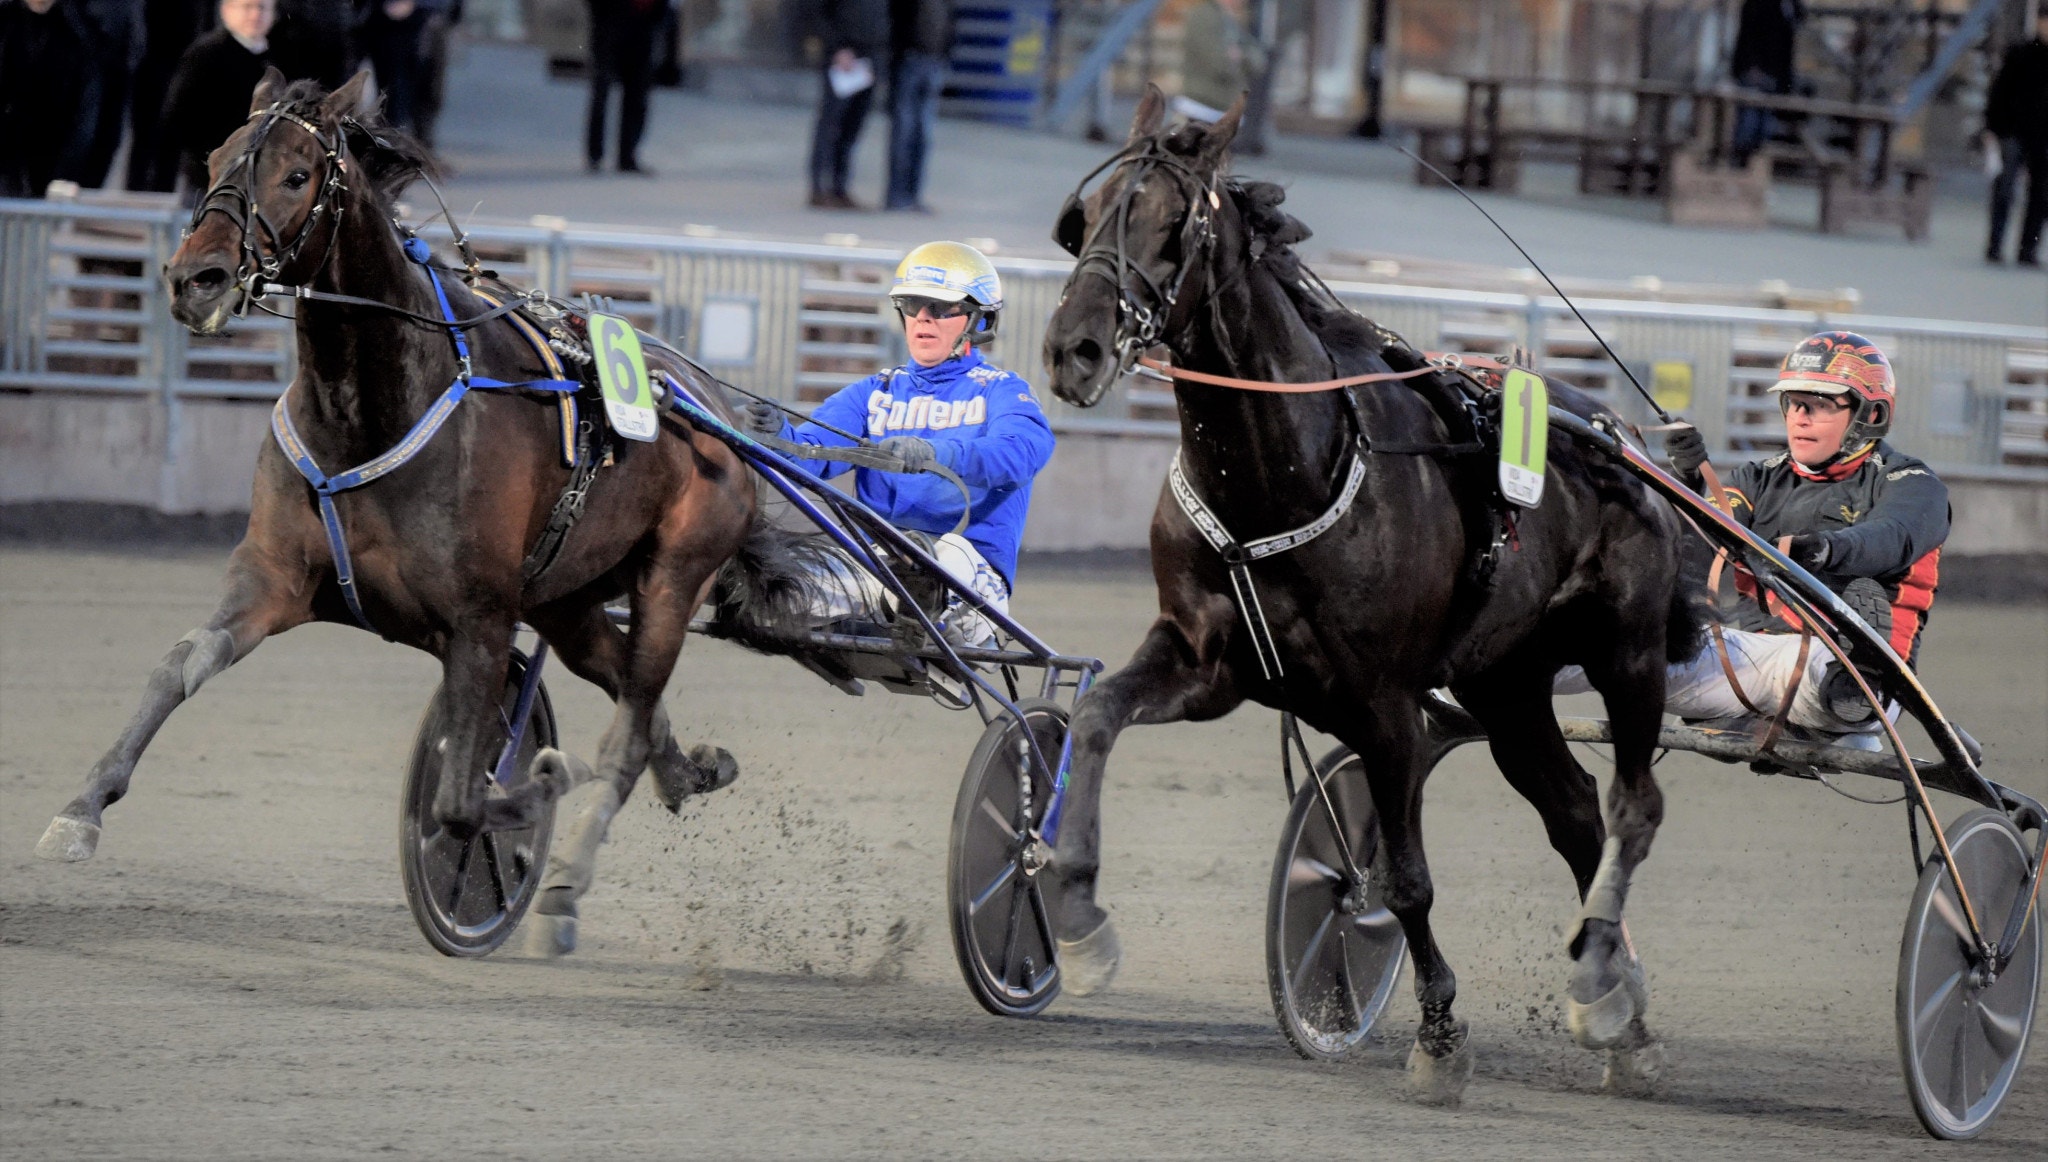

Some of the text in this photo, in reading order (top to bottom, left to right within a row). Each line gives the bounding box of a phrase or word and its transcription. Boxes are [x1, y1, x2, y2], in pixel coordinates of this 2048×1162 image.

[601, 318, 638, 404] 6
[867, 389, 986, 436] Sofiero
[1519, 378, 1533, 467] 1
